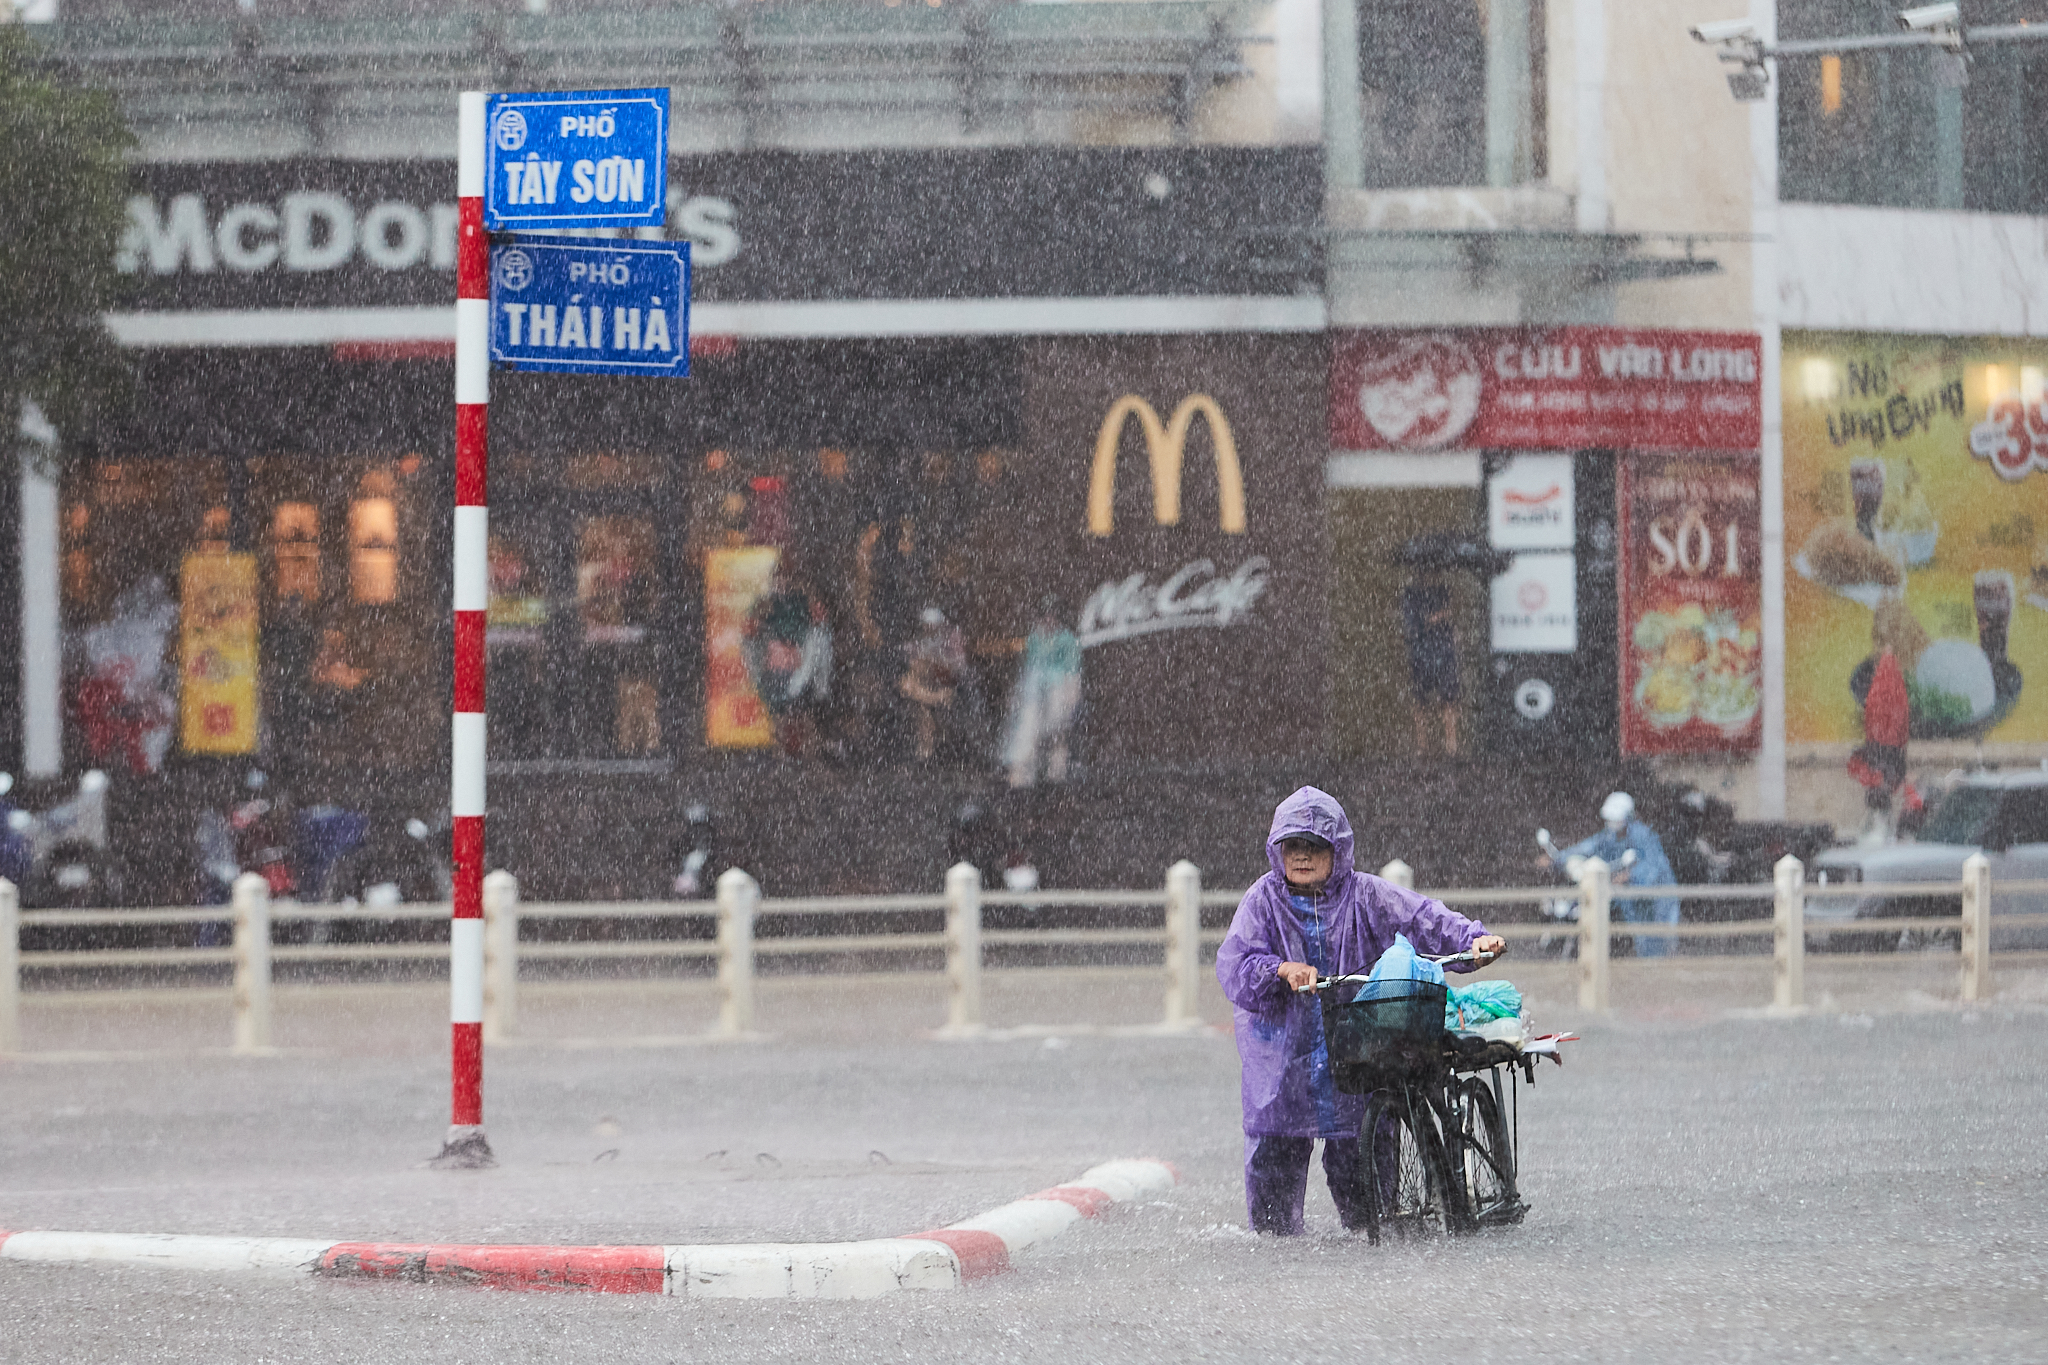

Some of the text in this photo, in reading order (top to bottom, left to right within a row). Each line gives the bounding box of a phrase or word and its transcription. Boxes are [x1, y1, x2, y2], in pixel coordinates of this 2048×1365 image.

[560, 107, 618, 138] PHỐ
[504, 152, 646, 205] TÂY SƠN
[570, 255, 631, 285] PHỐ
[503, 294, 672, 352] THÁI HÀ
